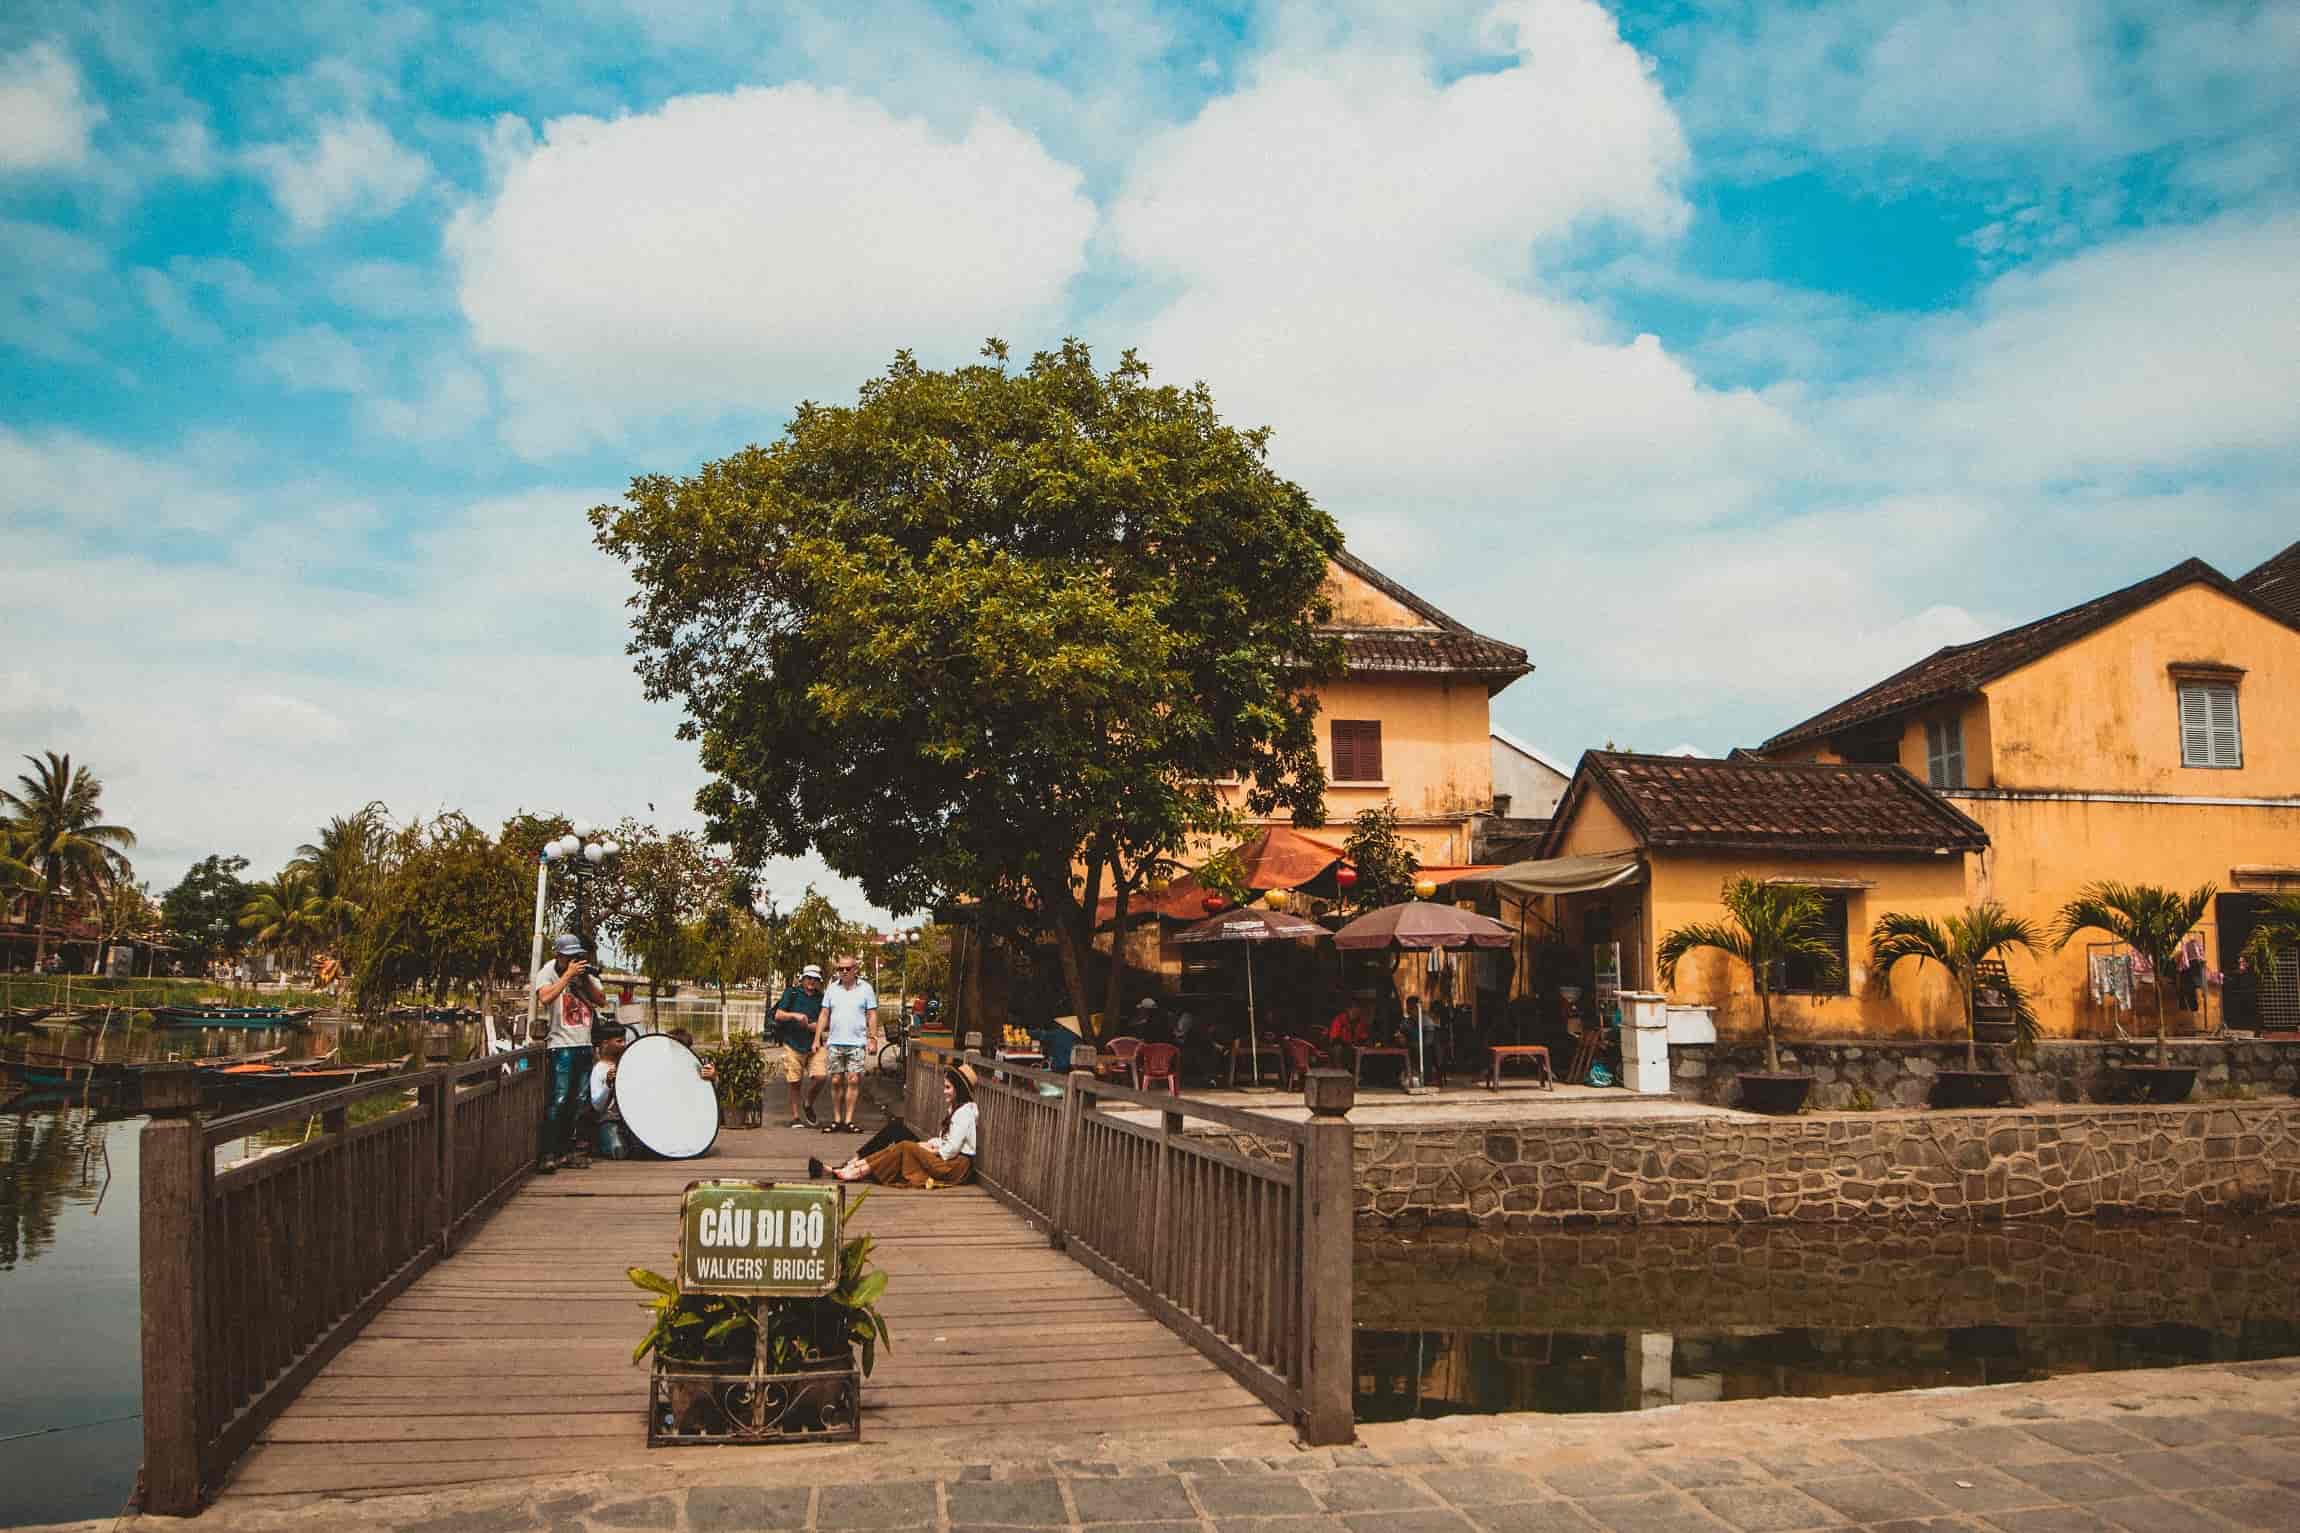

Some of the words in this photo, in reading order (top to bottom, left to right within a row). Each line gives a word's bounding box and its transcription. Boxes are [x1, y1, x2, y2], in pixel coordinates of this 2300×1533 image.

[699, 1198, 752, 1248] CẦU
[757, 1209, 785, 1248] ĐI
[789, 1203, 824, 1257] BỘ
[697, 1256, 768, 1280] WALKERS'
[773, 1258, 825, 1281] BRIDGE
